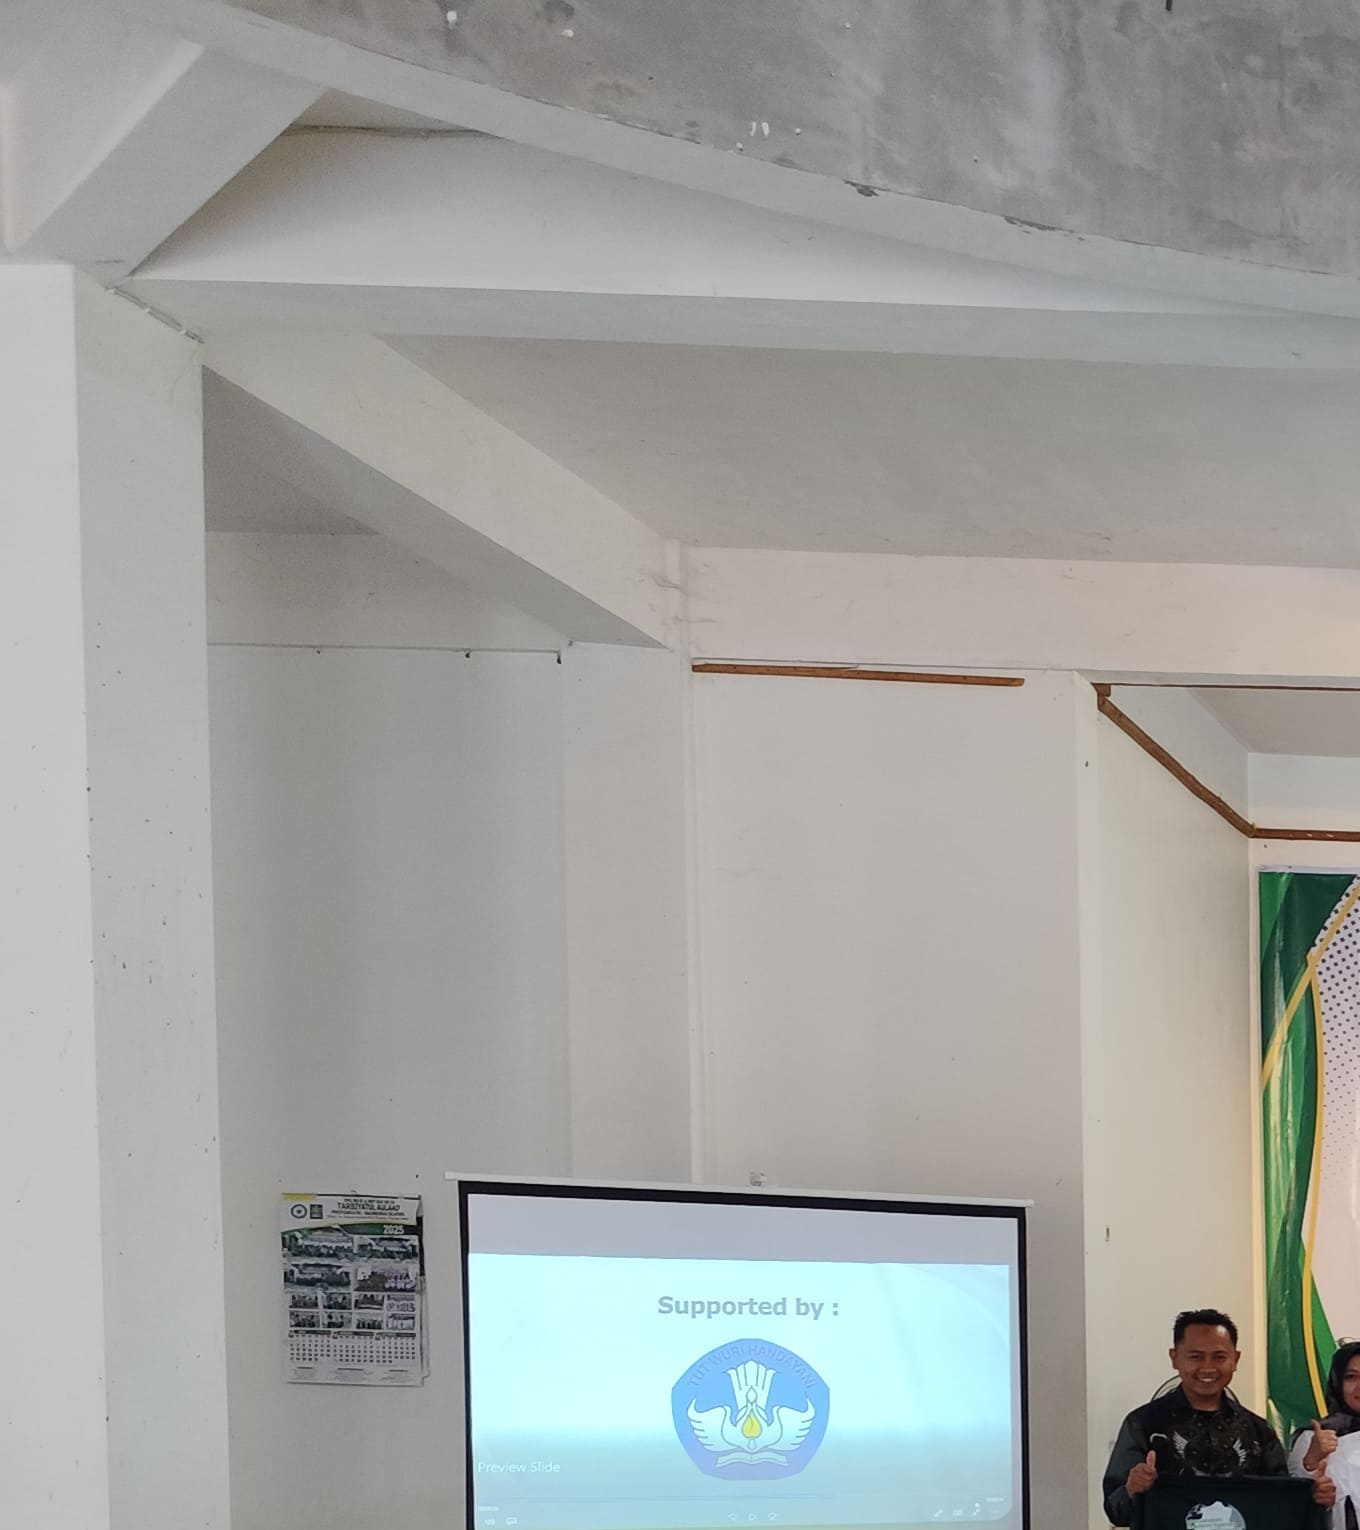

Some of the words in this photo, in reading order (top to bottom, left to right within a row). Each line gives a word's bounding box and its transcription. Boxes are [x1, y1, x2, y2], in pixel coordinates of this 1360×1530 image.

[383, 1225, 405, 1235] 2025
[657, 1296, 787, 1319] Supported
[795, 1297, 824, 1320] by
[687, 1362, 710, 1389] TUT
[749, 1345, 817, 1389] HANDAYANI
[478, 1461, 527, 1473] Preview
[530, 1461, 561, 1473] Slide
